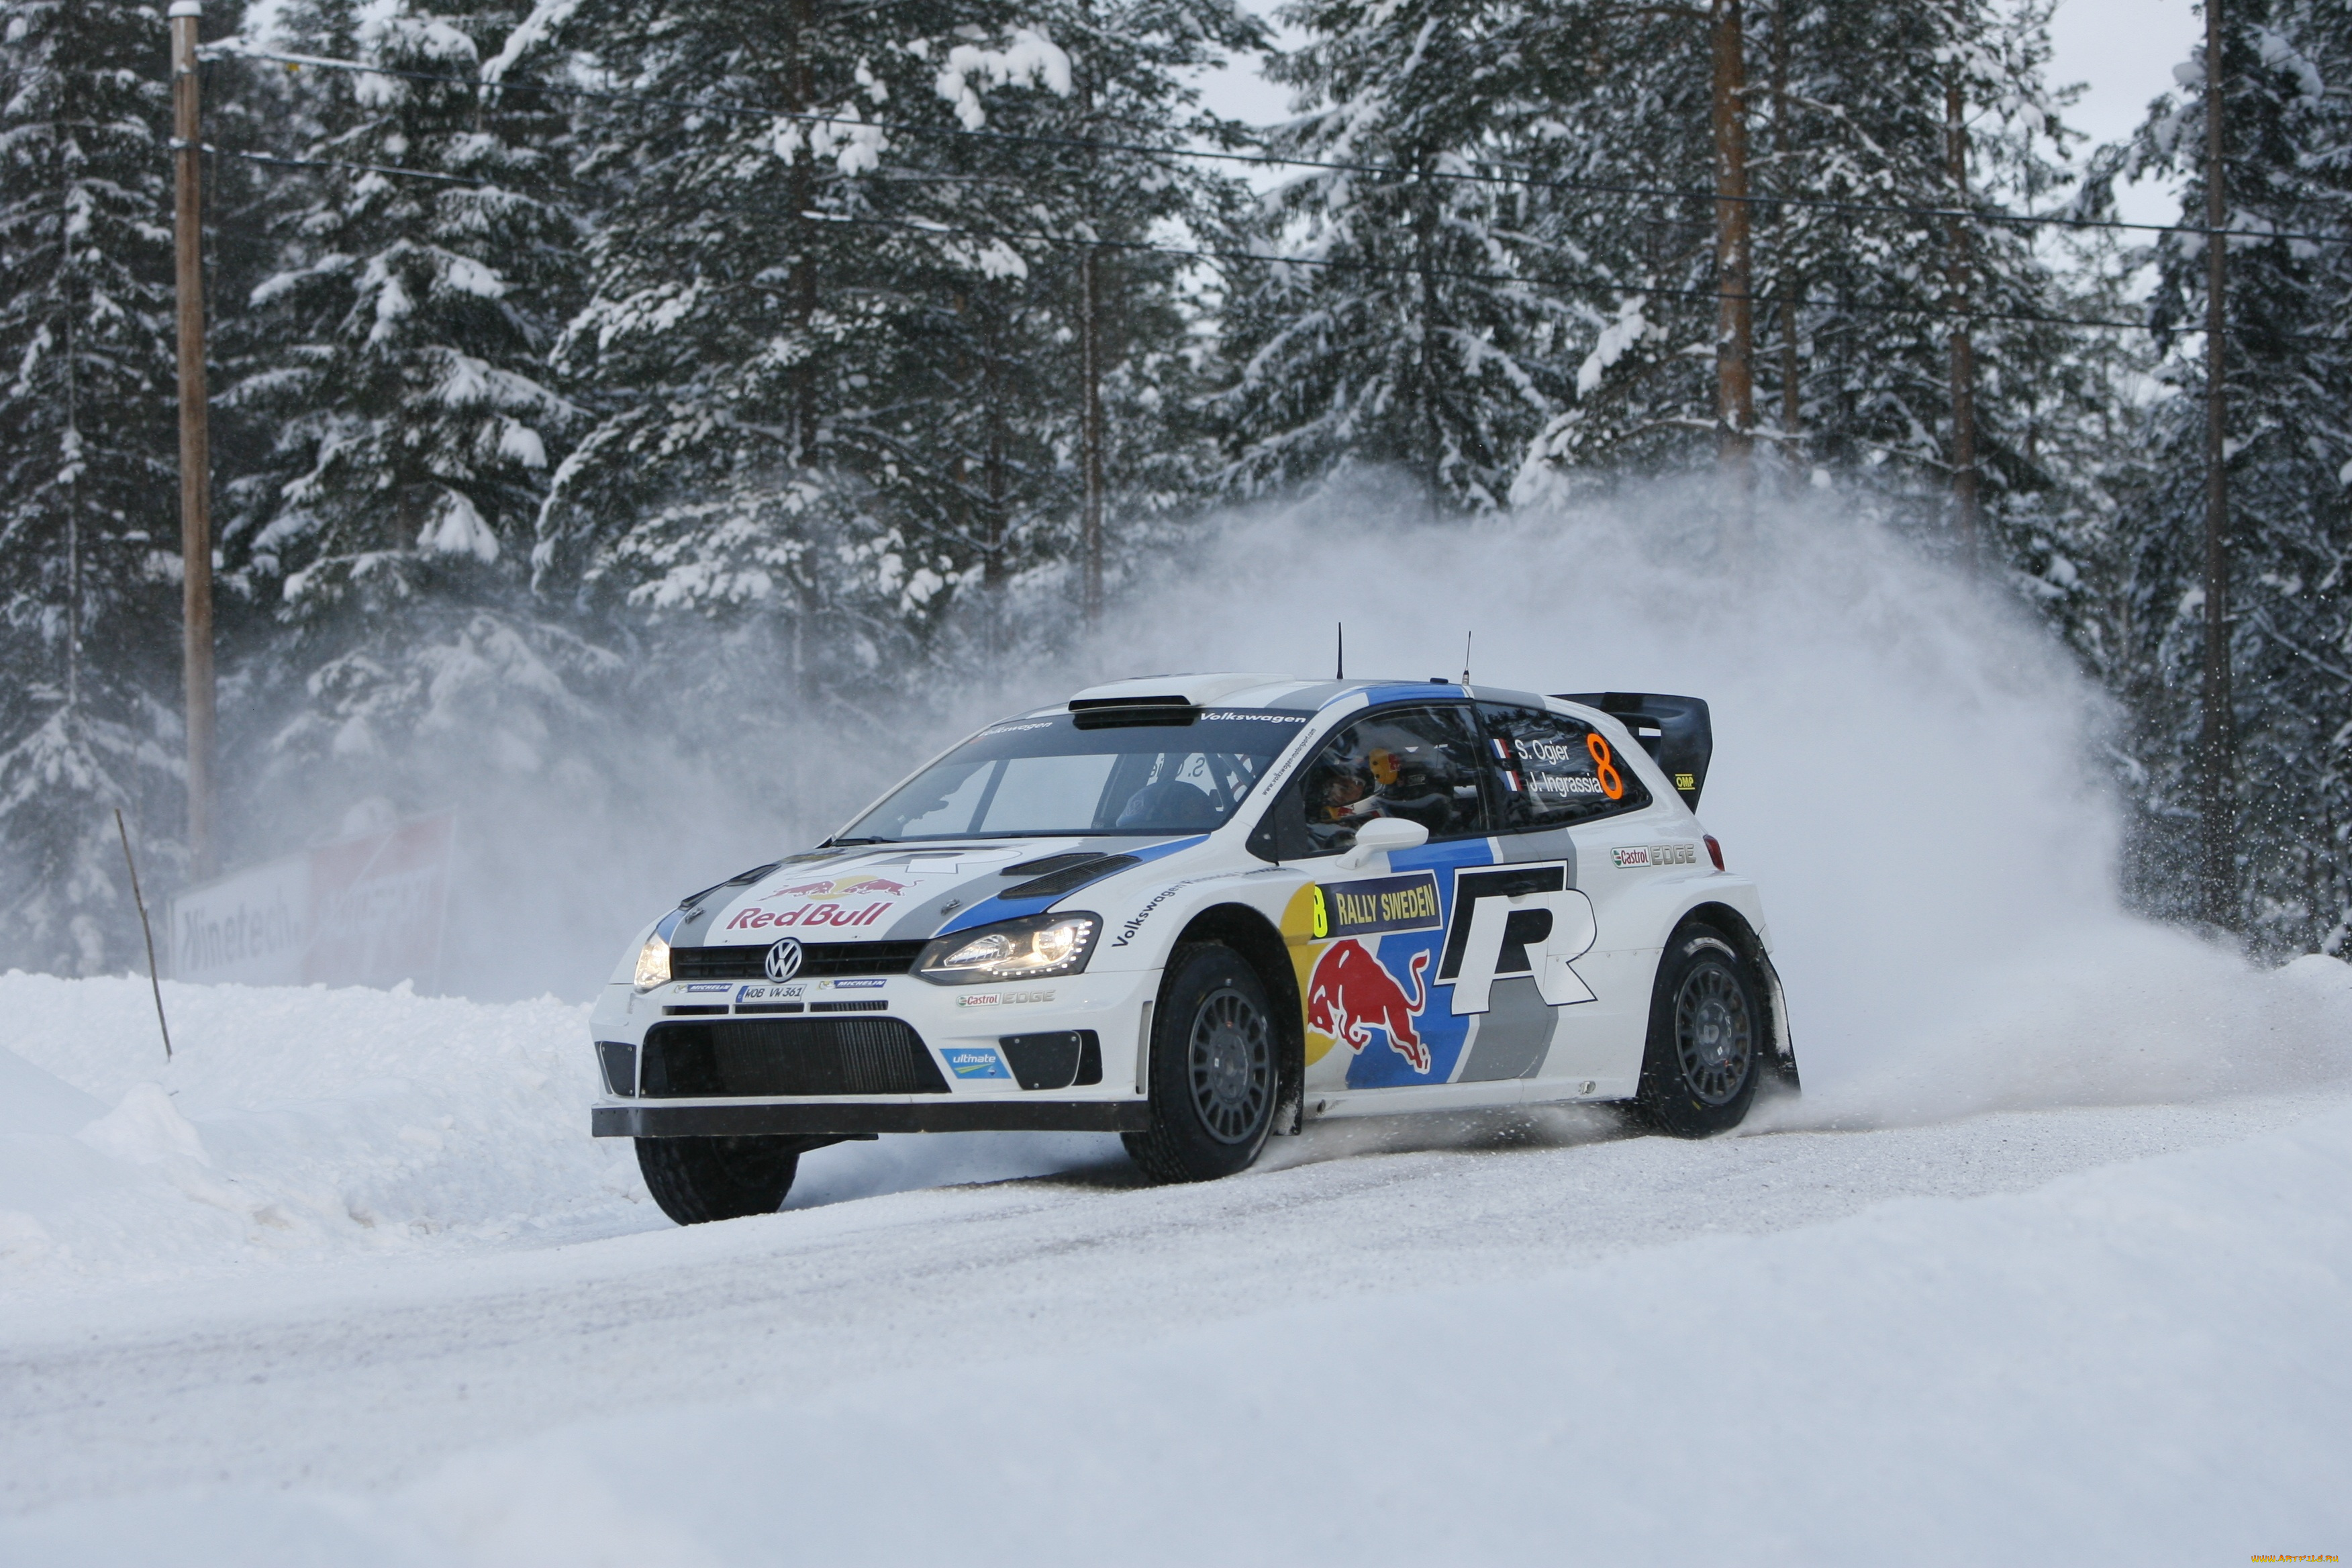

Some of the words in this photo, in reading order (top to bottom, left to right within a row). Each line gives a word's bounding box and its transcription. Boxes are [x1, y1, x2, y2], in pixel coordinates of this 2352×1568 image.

[1200, 712, 1307, 724] Volkswagen
[1514, 739, 1532, 760] S.
[1532, 740, 1570, 765] Ogier
[1587, 732, 1624, 800] 8
[1530, 771, 1542, 792] J.
[1543, 771, 1604, 797] Ingrassia
[1676, 776, 1694, 787] OMP
[1620, 849, 1649, 865] Castrol
[1651, 844, 1697, 866] EDGE
[725, 903, 814, 930] Red
[800, 901, 894, 926] Bull
[1112, 883, 1187, 948] Volkswagen
[1335, 893, 1377, 926] RALLY
[1381, 883, 1436, 922] SWEDEN
[1443, 873, 1598, 1017] R
[744, 988, 765, 999] WOB
[782, 987, 803, 997] 361
[967, 994, 998, 1006] Castrol
[1001, 989, 1057, 1005] EDGE
[952, 1054, 996, 1063] ultimate
